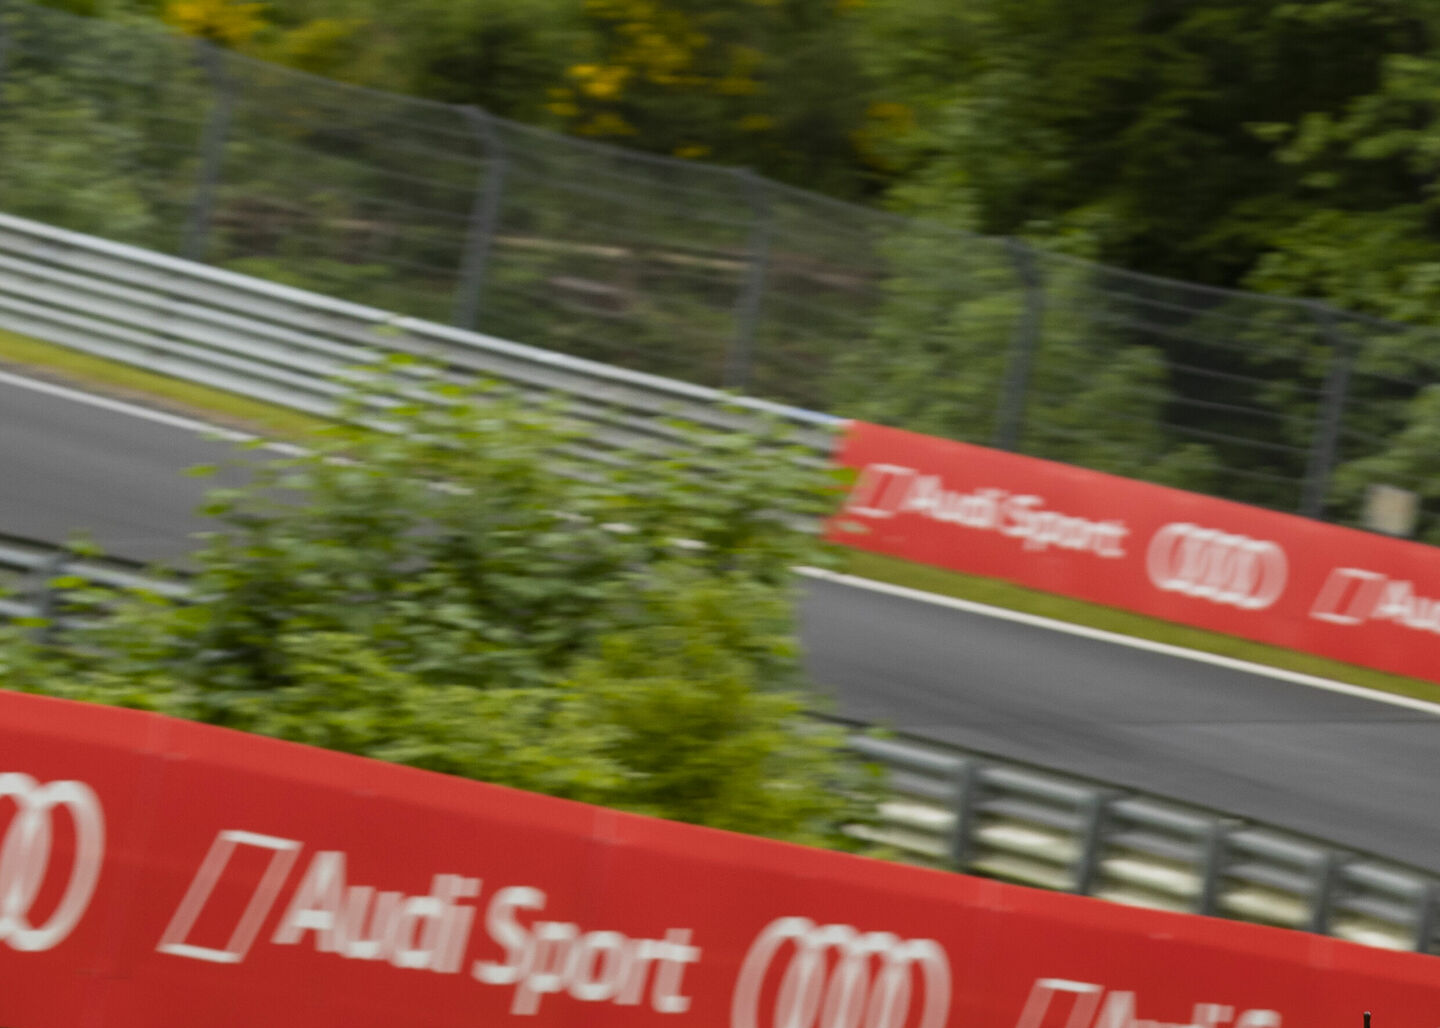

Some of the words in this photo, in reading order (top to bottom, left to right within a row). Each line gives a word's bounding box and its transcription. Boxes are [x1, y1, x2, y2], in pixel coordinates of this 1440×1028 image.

[906, 474, 1008, 530] Audi
[1000, 494, 1129, 558] Sport
[270, 850, 483, 974] Audi
[472, 886, 702, 1015] Sport
